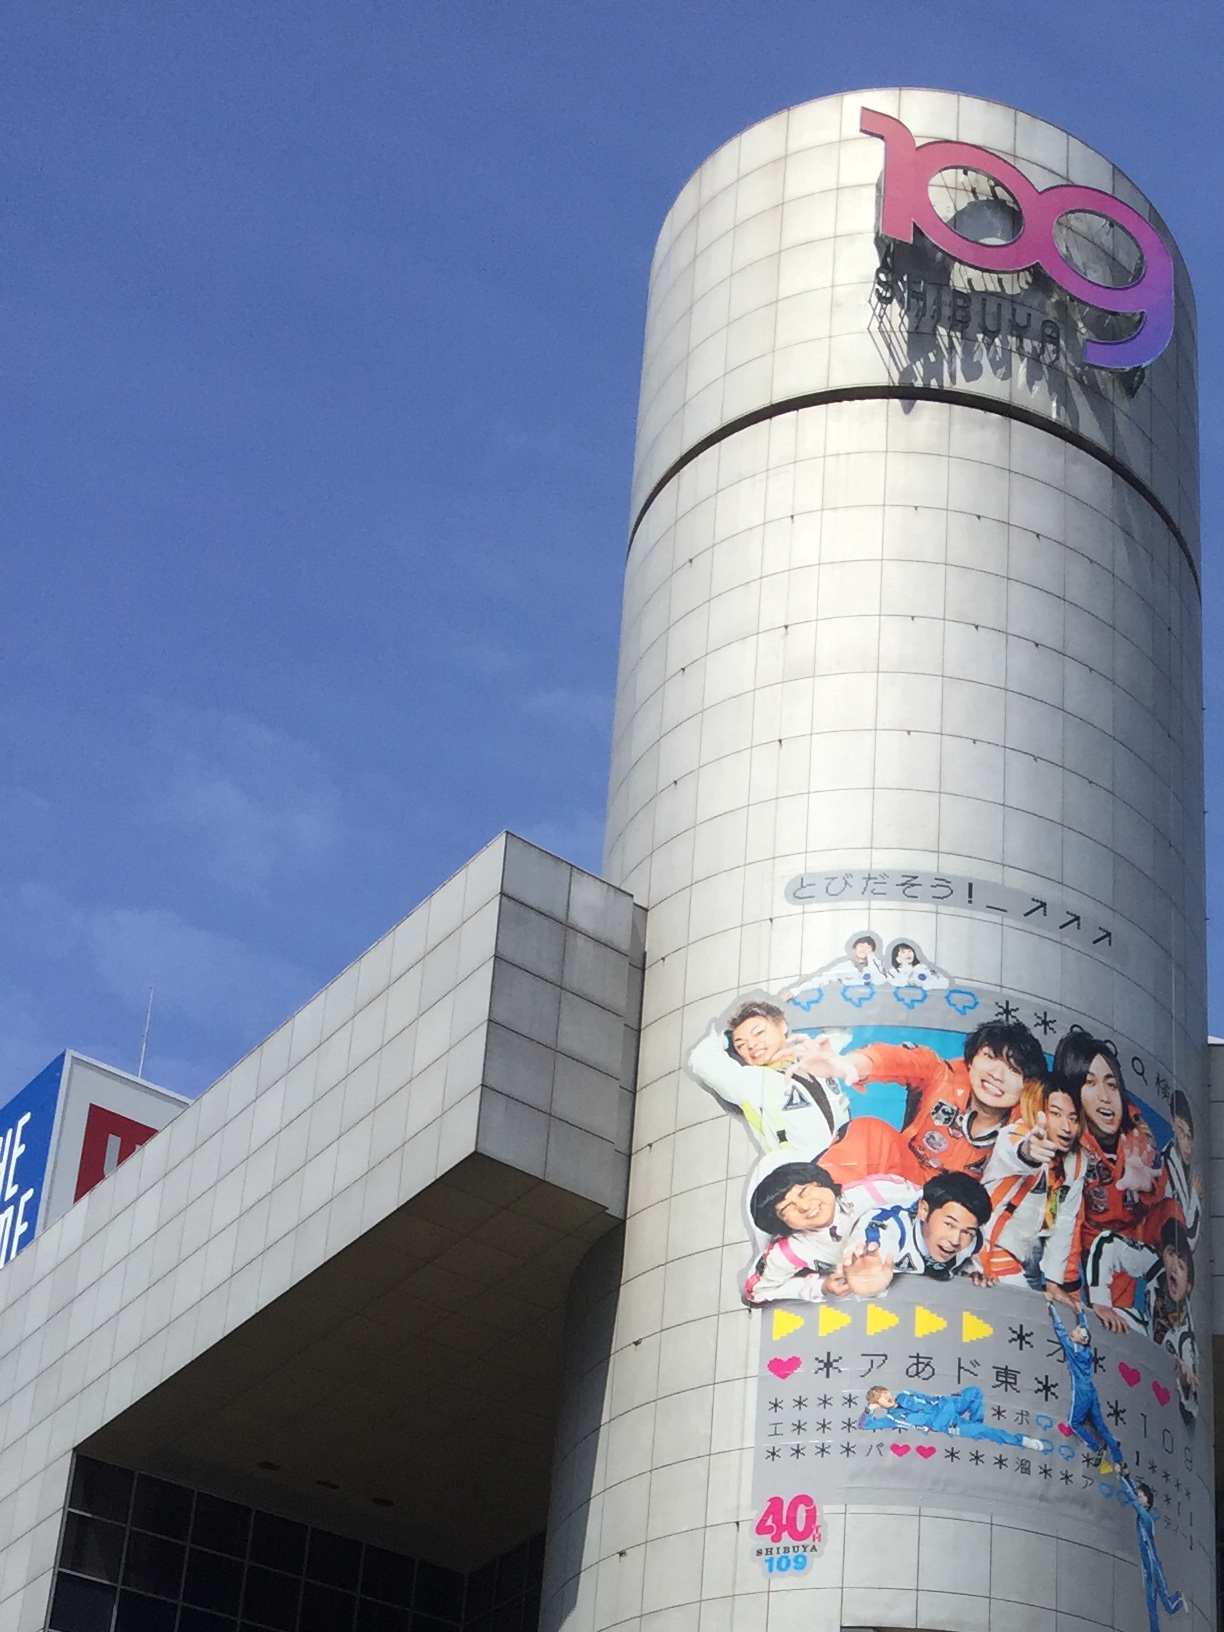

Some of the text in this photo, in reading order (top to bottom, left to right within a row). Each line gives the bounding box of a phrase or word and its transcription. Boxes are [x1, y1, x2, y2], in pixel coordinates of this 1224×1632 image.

[859, 106, 1175, 370] 109
[874, 267, 1061, 364] SHIBUYA
[755, 1494, 817, 1543] 40
[756, 1544, 818, 1557] SHIBUYA
[764, 1553, 808, 1574] 109
